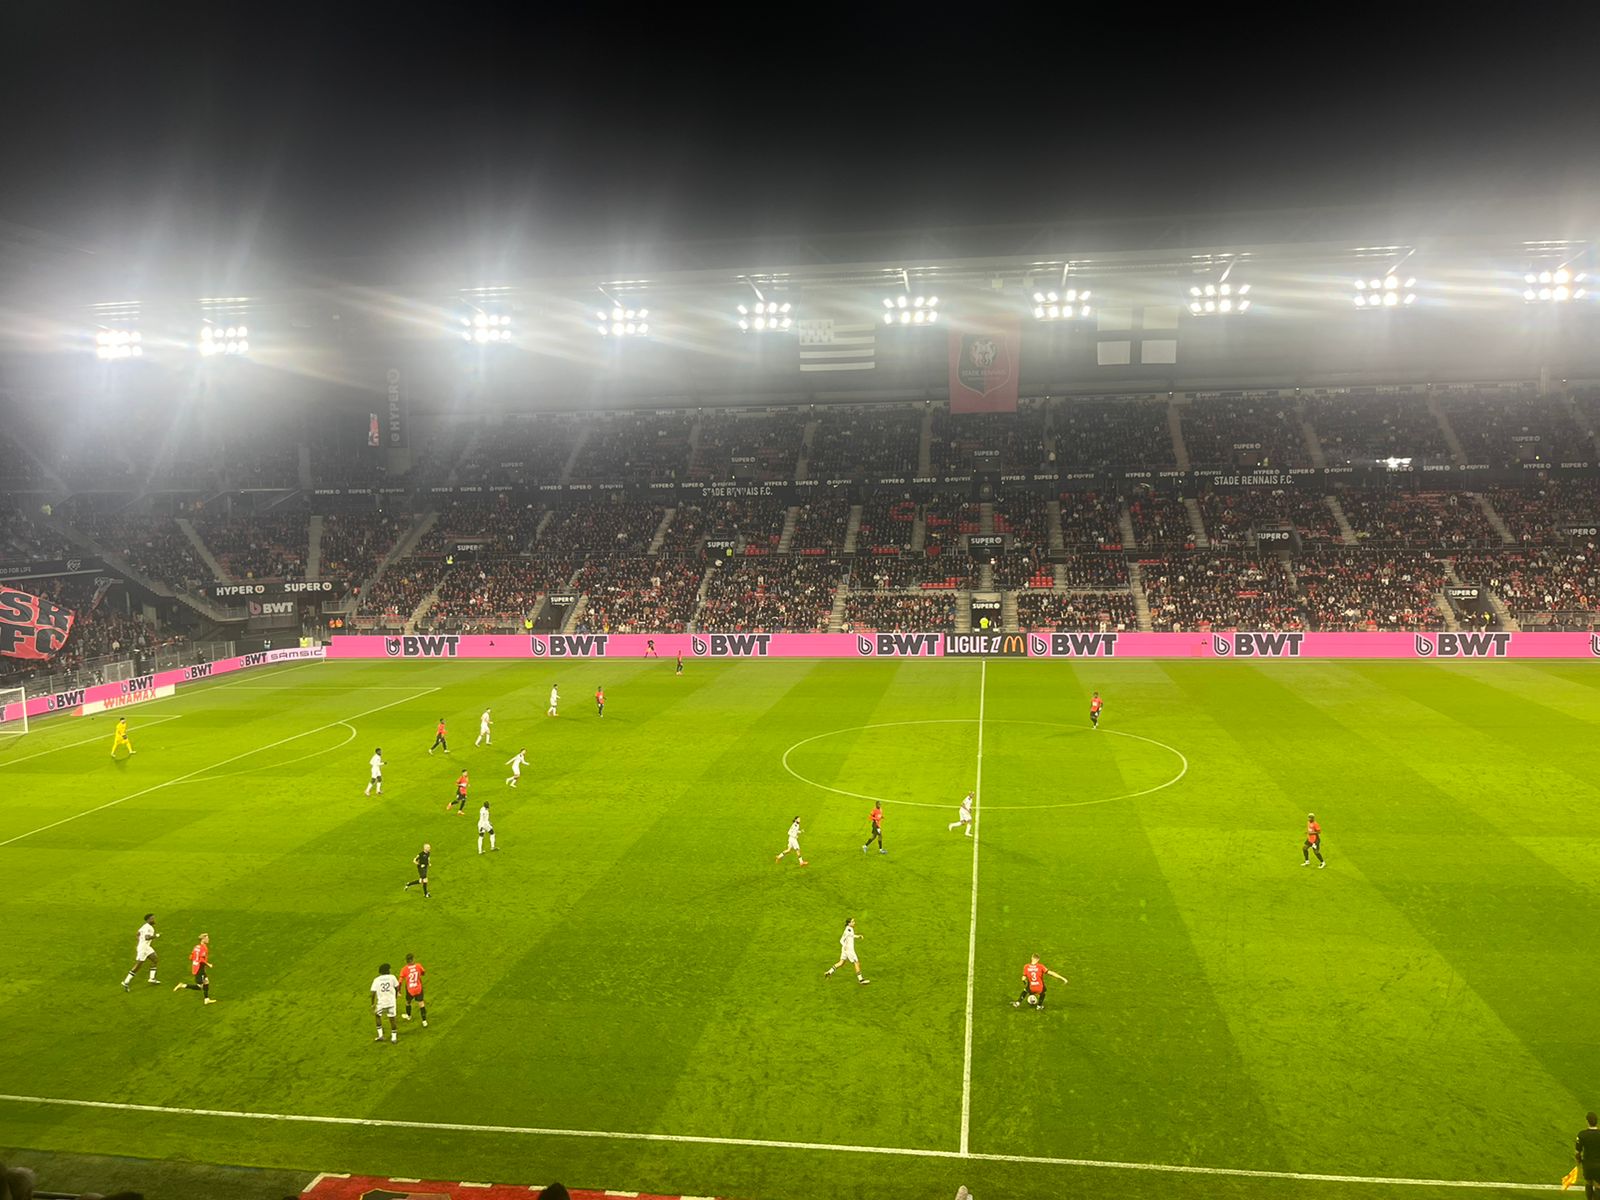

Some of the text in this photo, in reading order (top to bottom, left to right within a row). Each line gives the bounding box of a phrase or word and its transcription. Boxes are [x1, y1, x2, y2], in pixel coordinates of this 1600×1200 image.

[1214, 474, 1295, 486] STADE RENNAIS F.C.
[707, 541, 729, 549] SUPER
[971, 537, 994, 545] SUPER
[216, 585, 254, 596] HYPER
[284, 582, 321, 592] SUPER
[262, 602, 294, 614] BWT
[403, 636, 459, 656] BWT
[550, 636, 608, 656] BWT
[710, 634, 771, 656] BWT
[876, 633, 940, 656] BWT
[946, 636, 988, 653] LIGUE
[1051, 633, 1117, 656] BWT
[1233, 633, 1303, 656] BWT
[1437, 633, 1511, 656] BWT
[245, 653, 267, 666] BWT
[271, 649, 323, 660] SAMSIC
[191, 664, 213, 678] BWT
[129, 676, 153, 692] BWT
[56, 689, 85, 708] BWT
[104, 689, 156, 708] WINAMAX
[380, 982, 390, 992] 32
